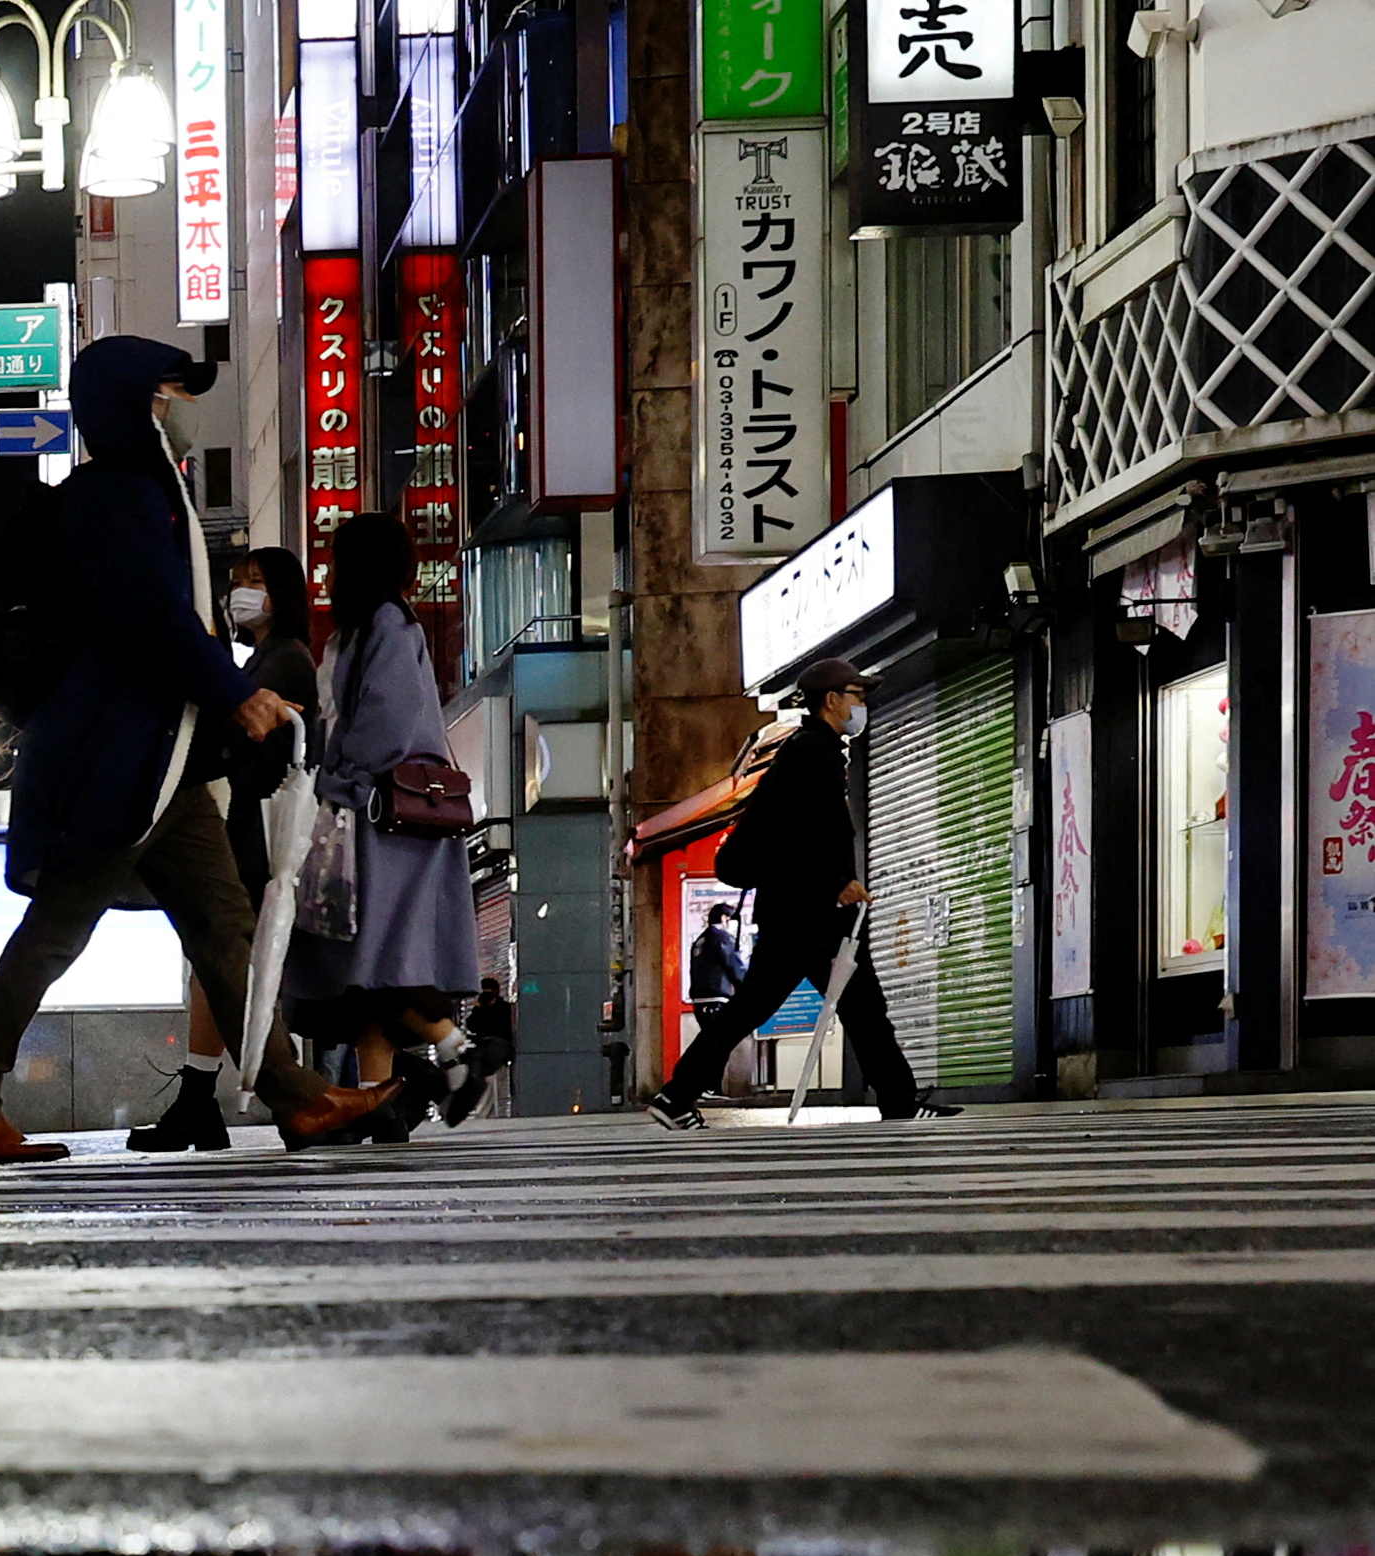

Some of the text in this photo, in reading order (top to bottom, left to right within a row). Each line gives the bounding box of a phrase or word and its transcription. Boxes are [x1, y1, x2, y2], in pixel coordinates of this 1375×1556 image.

[898, 0, 983, 80] 売
[901, 111, 982, 136] 2号店
[184, 119, 223, 302] 三平本館
[735, 194, 792, 211] TRUST
[719, 291, 733, 330] 1F
[741, 212, 799, 544] カワノ・トラスト
[719, 375, 735, 541] 03-3354-4032
